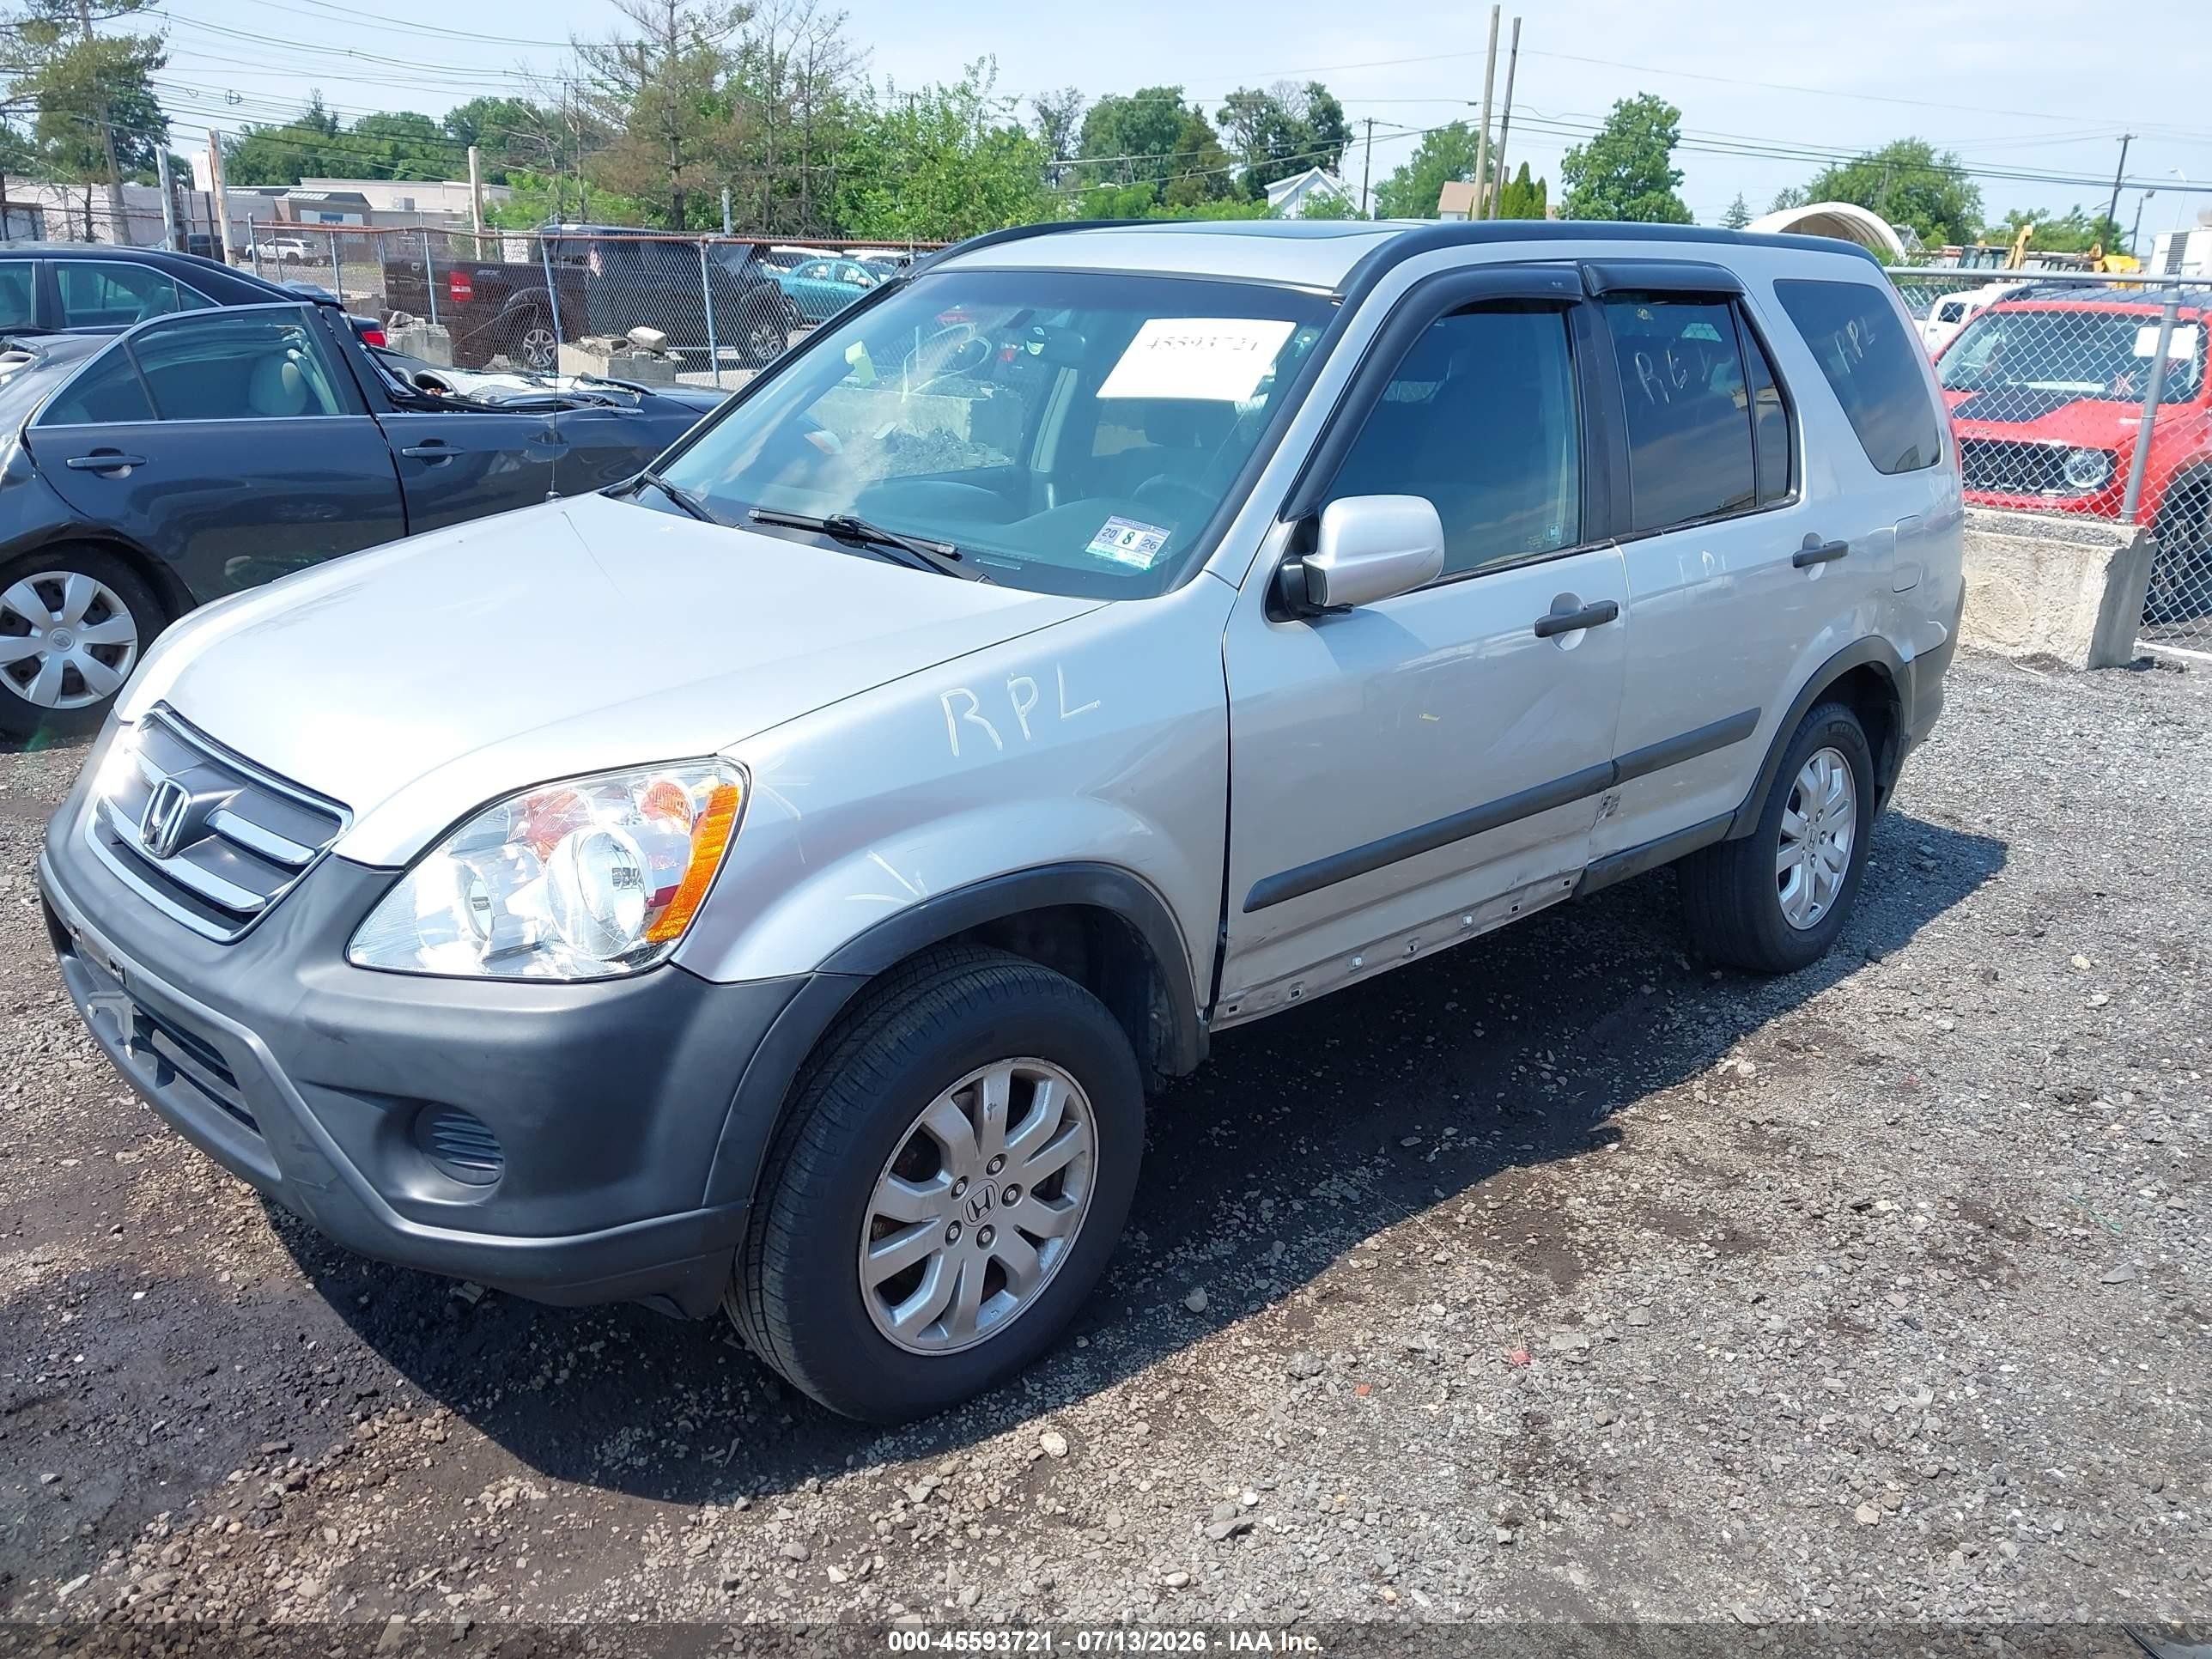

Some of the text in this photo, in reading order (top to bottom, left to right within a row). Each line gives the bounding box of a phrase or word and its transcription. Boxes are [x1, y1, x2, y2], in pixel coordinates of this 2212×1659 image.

[1102, 527, 1159, 550] 20 8 26
[939, 663, 1102, 757] RPL
